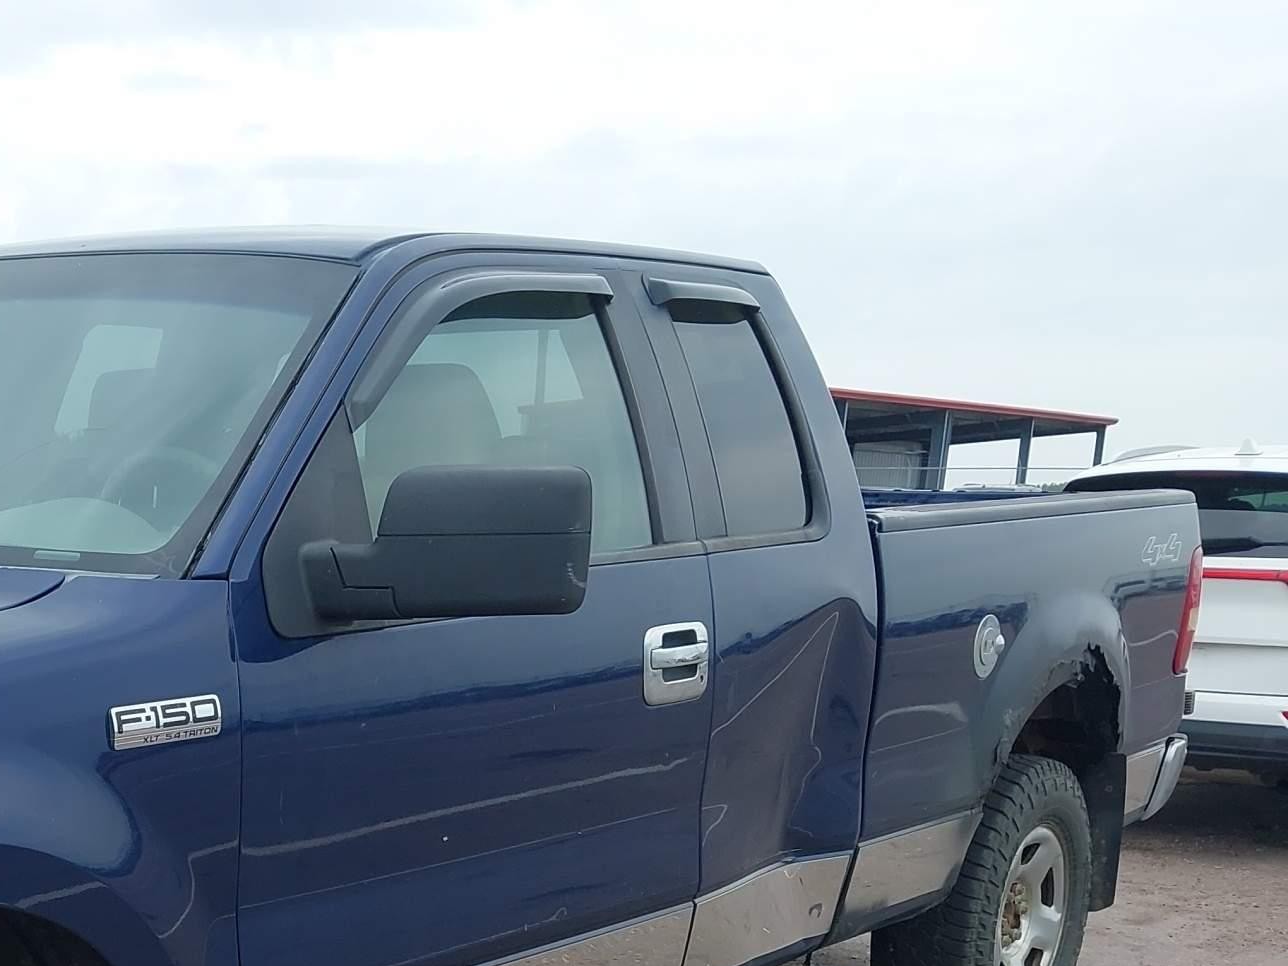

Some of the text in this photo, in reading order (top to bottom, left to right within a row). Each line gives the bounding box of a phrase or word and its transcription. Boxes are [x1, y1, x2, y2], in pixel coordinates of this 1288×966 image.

[1141, 532, 1183, 566] 4x4
[115, 698, 219, 734] F-150
[142, 734, 160, 744] XLT
[183, 725, 219, 739] TRITON
